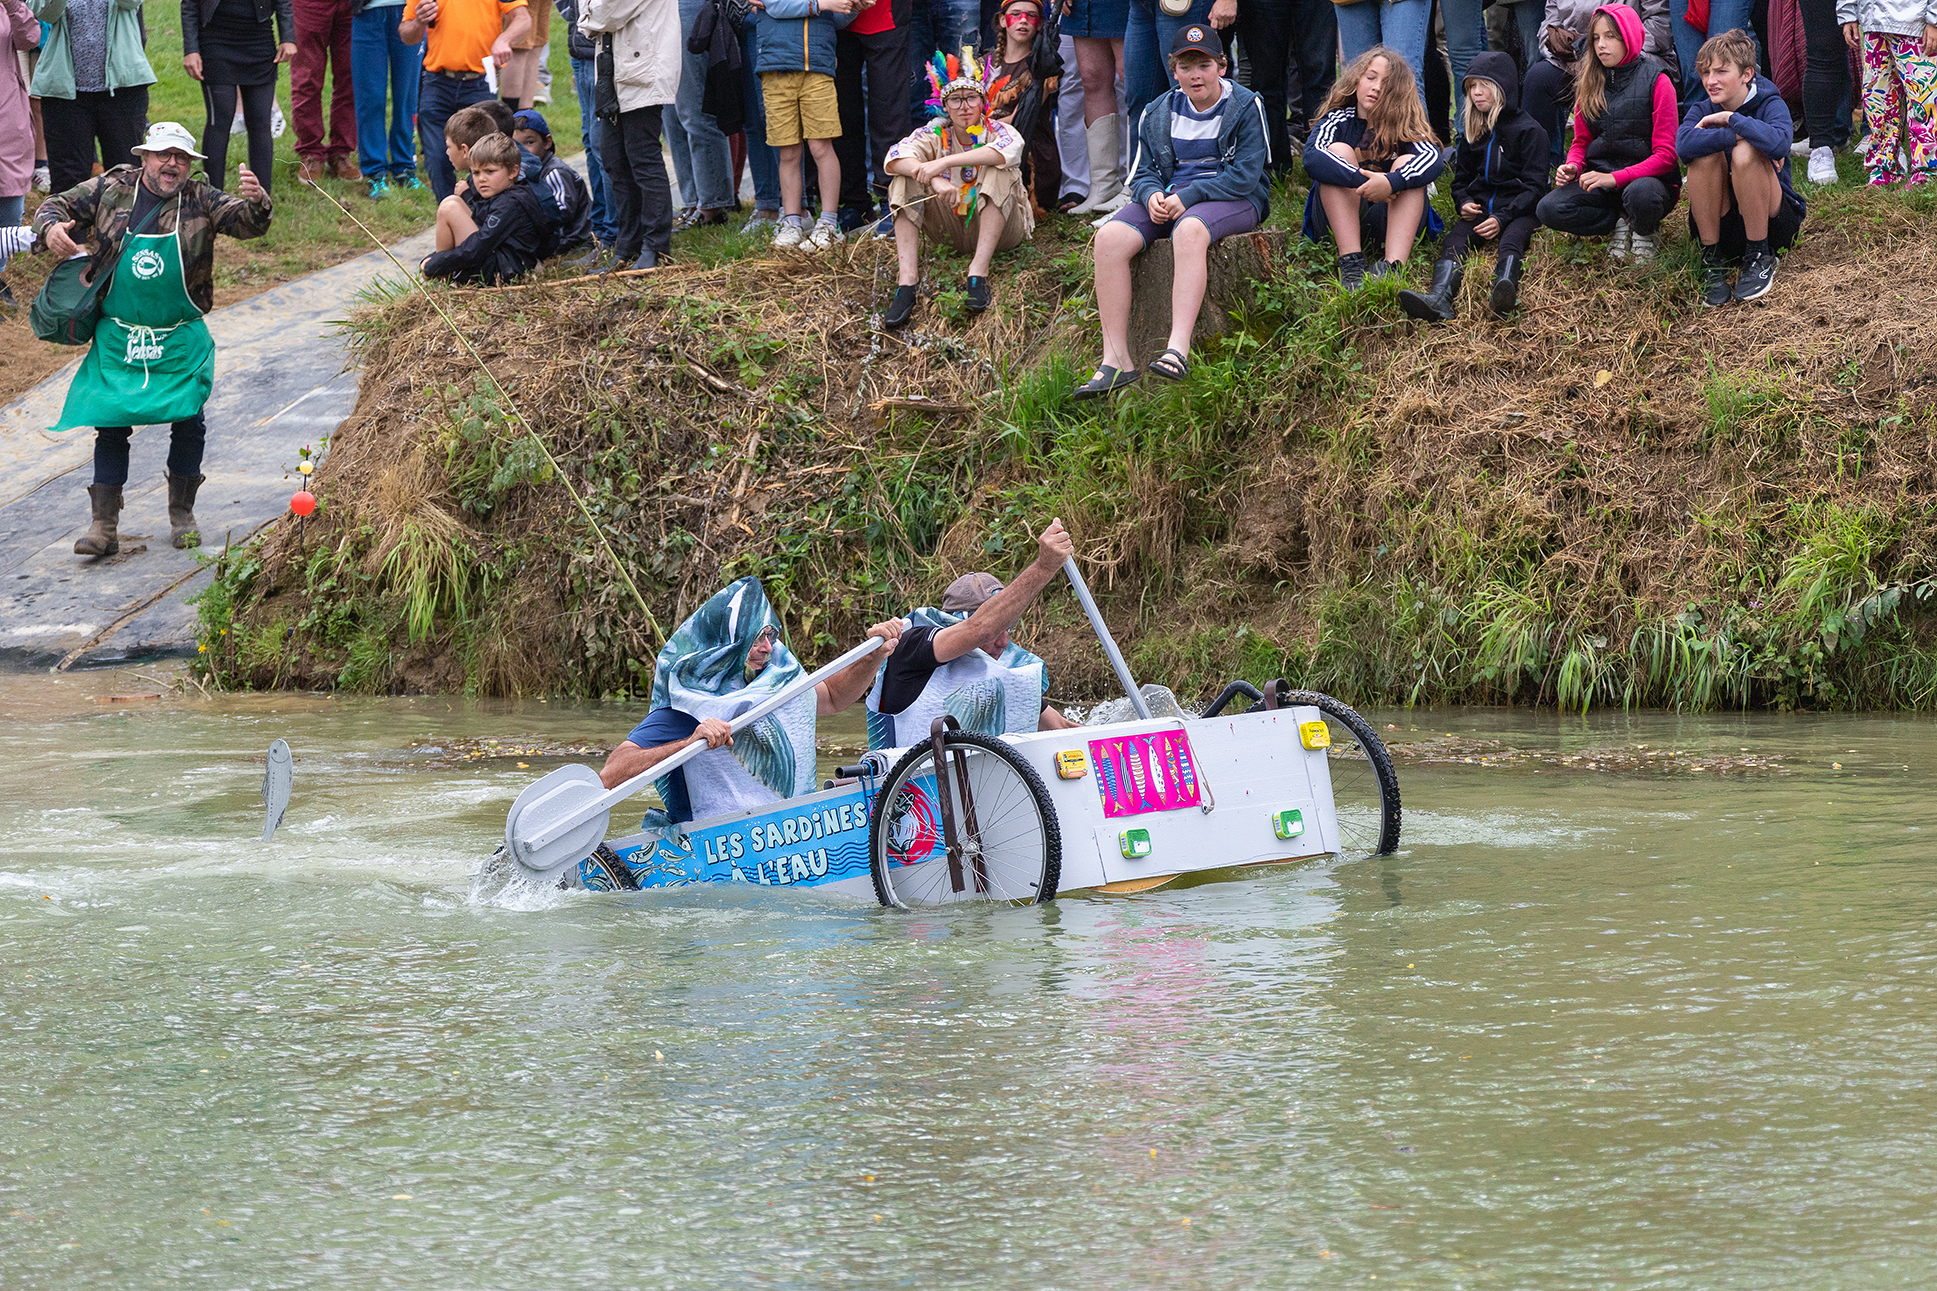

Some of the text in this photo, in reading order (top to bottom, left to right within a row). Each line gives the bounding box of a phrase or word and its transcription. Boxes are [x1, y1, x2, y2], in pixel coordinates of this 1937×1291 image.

[131, 248, 160, 263] SENSAS
[704, 832, 744, 865] LES
[756, 848, 828, 886] L'EAU
